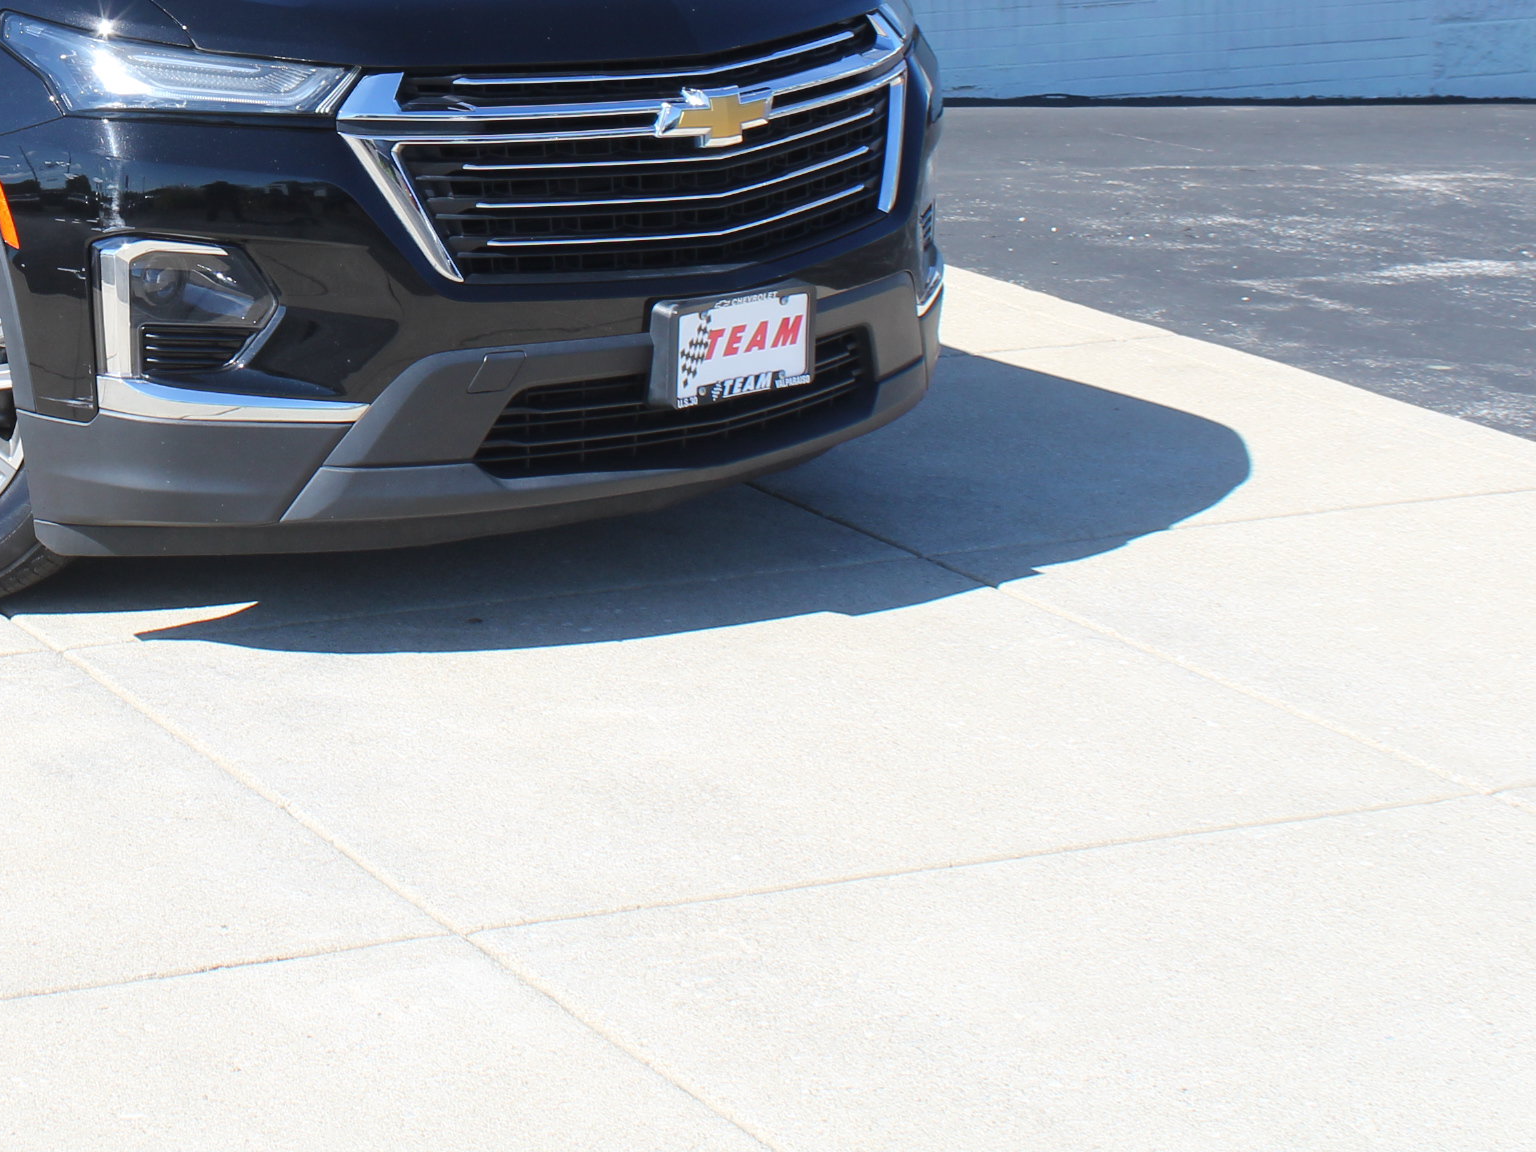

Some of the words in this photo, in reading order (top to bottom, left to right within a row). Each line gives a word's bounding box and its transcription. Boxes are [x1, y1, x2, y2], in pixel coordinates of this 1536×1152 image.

[731, 291, 779, 305] CHEVROLET
[705, 314, 804, 361] TEAM
[722, 371, 773, 397] TEAM
[775, 374, 811, 388] VALPARAISO
